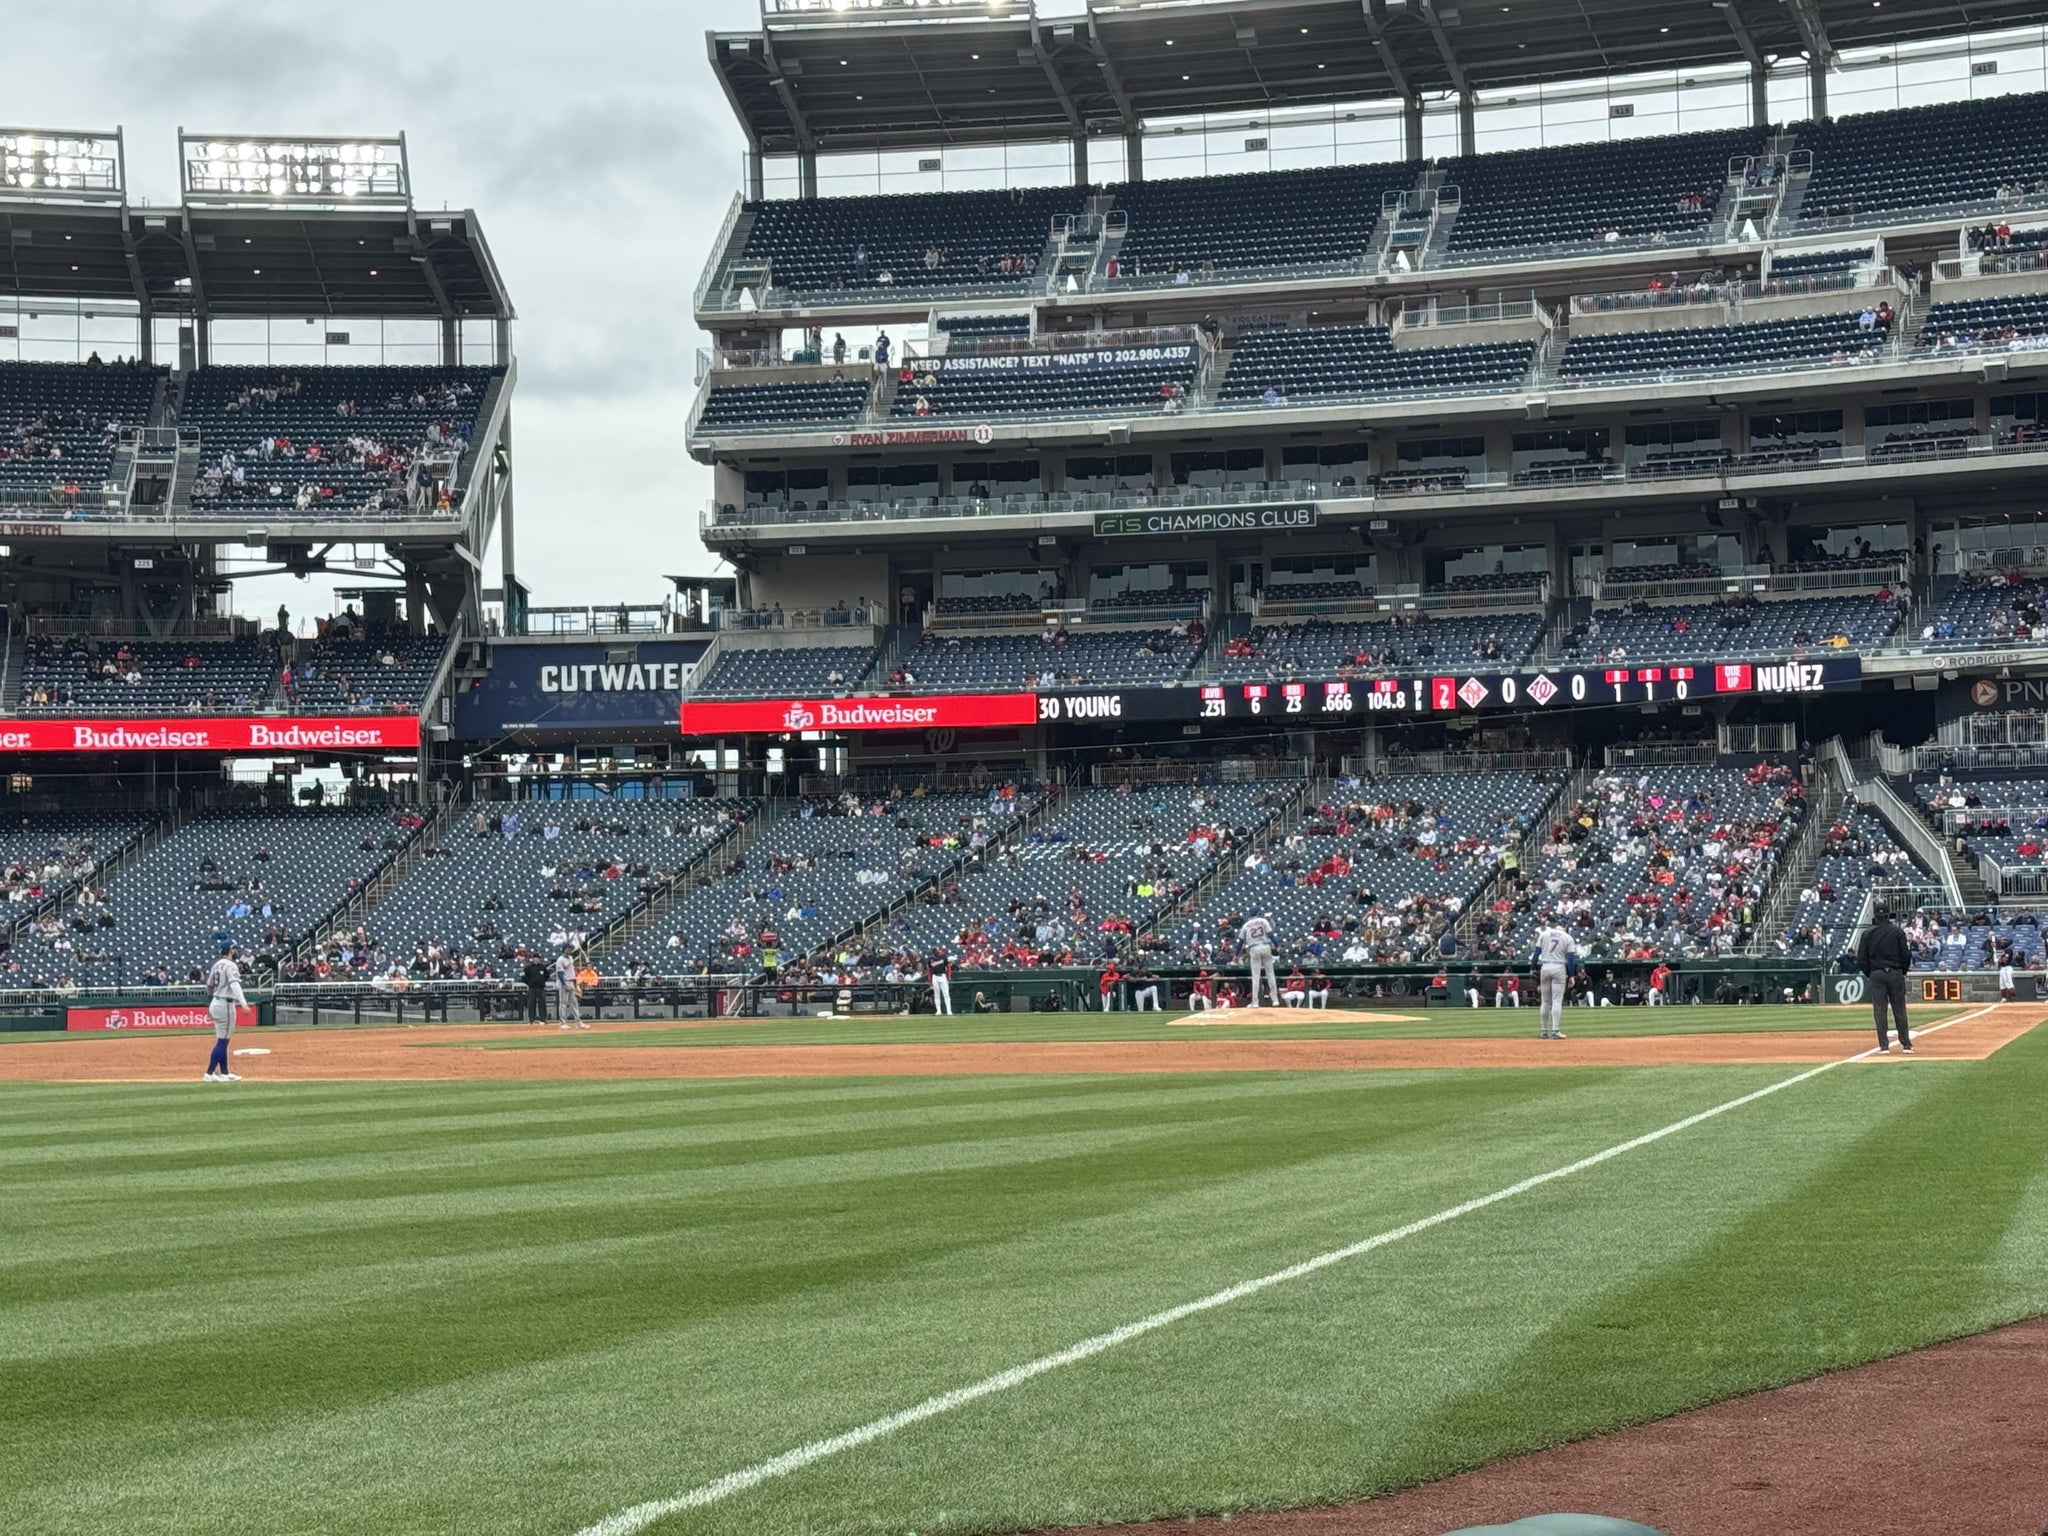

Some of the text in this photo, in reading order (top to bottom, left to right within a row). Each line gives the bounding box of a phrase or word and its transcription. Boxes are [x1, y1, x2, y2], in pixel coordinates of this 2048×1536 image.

[910, 360, 941, 372] NEED
[944, 358, 1019, 370] ASSISTANCE?
[1021, 355, 1051, 367] TEXT
[1096, 351, 1113, 363] TO
[1115, 346, 1191, 362] 202.980.4357
[850, 429, 990, 446] RYAN ZIMMERMAN 11
[1147, 512, 1256, 531] CHAMPIONS
[1262, 509, 1310, 526] CLUB
[11, 524, 61, 536] WERTH
[1949, 655, 2021, 667] RODRIGUEZ
[1724, 665, 1741, 677] DUE
[1757, 661, 1824, 693] NUÑEZ
[1502, 677, 1516, 703] 0
[1571, 674, 1586, 700] 0
[1646, 682, 1653, 700] 1
[1676, 681, 1687, 700] 0
[1727, 677, 1739, 688] UP
[2003, 681, 2048, 702] PN
[1367, 691, 1406, 710] 104.8
[1439, 684, 1450, 704] 2
[1614, 683, 1621, 702] 1
[1039, 696, 1121, 719] 30 YOUNG
[1200, 699, 1226, 717] .231
[1251, 696, 1261, 714] 6
[1286, 695, 1302, 712] 23
[1321, 693, 1353, 711] .666
[820, 704, 937, 725] Budweiser
[1251, 926, 1264, 939] 23
[1551, 940, 1559, 952] 7
[133, 1011, 214, 1026] Budweise
